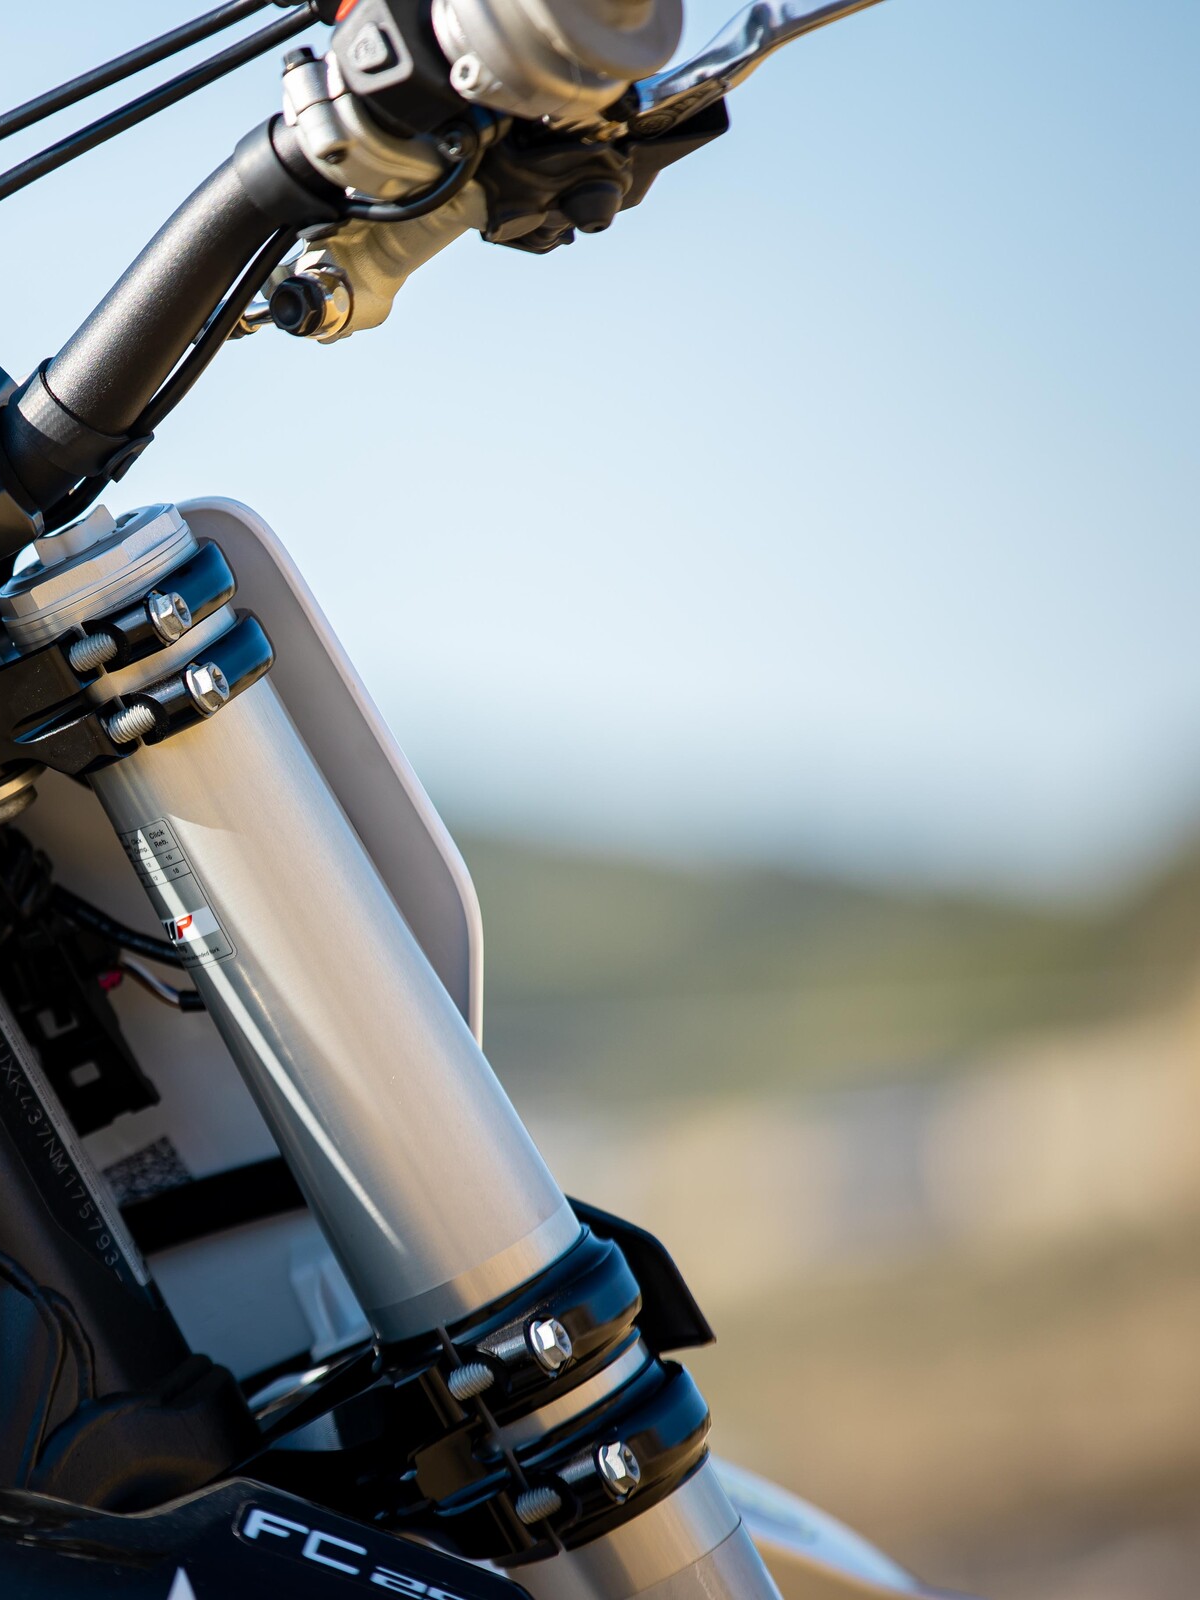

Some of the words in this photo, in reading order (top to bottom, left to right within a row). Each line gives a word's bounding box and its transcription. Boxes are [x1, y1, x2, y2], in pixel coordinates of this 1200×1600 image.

[149, 829, 165, 840] Click
[154, 840, 169, 848] Reb.
[243, 1509, 368, 1576] FC
